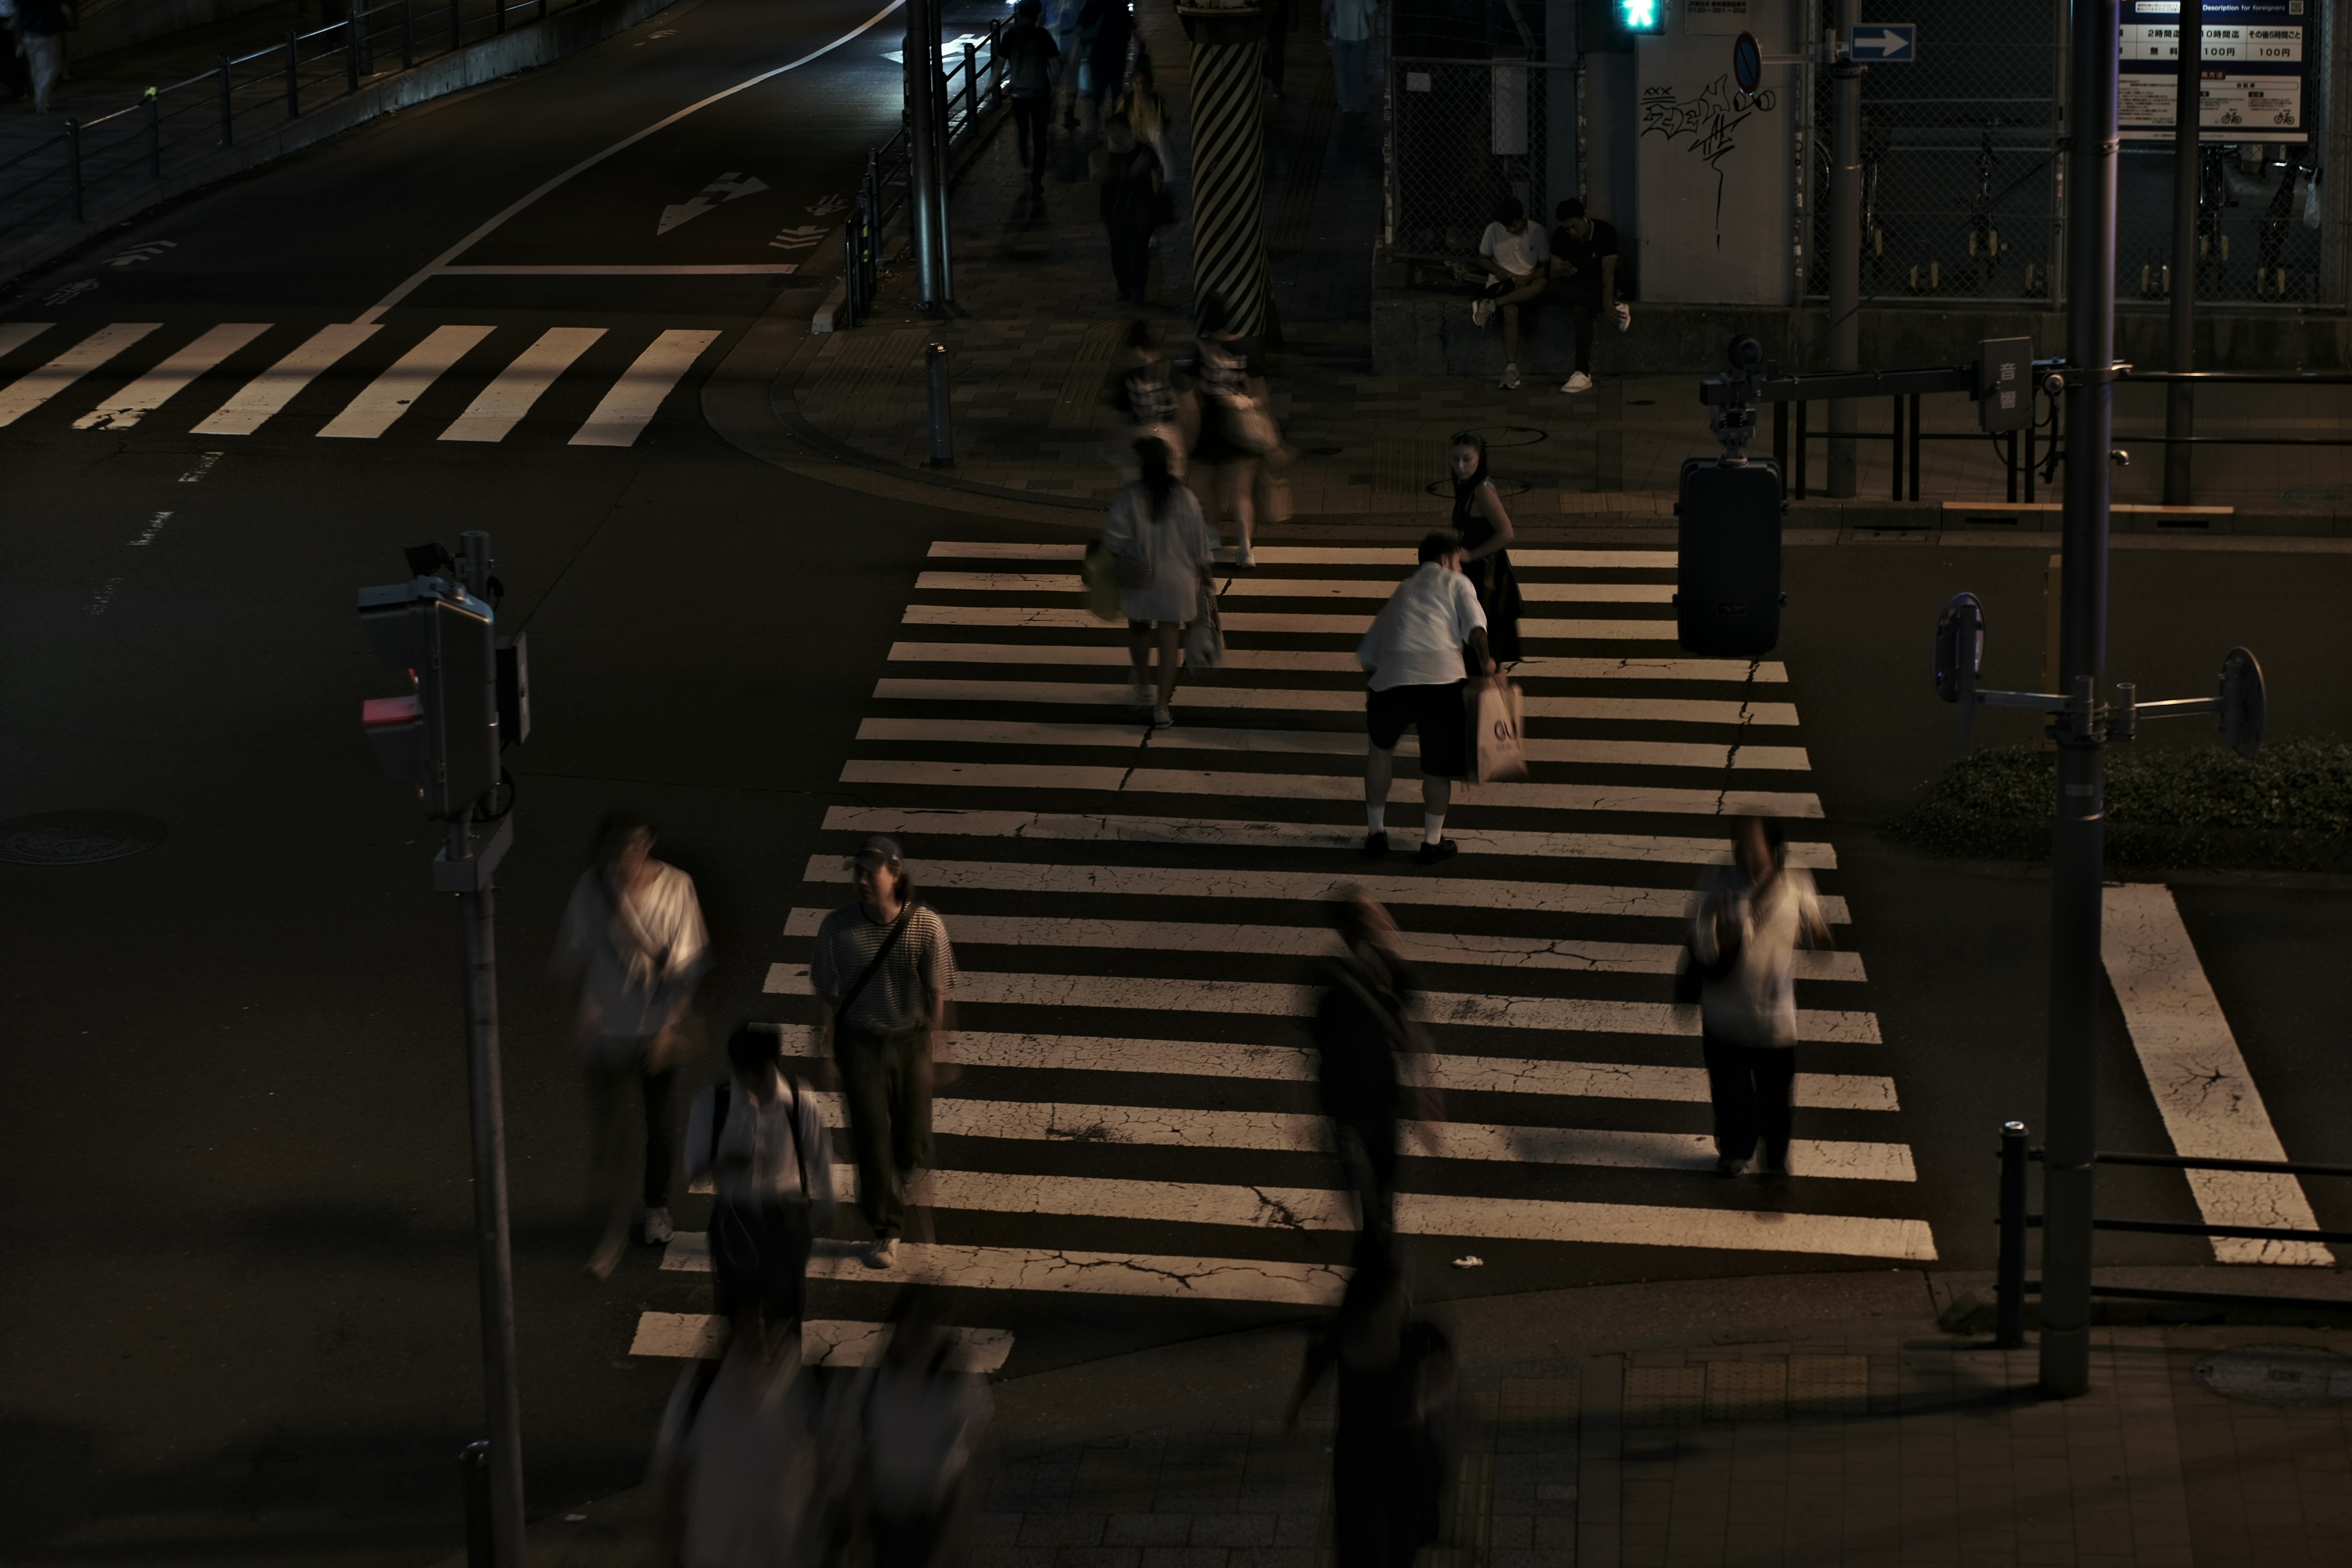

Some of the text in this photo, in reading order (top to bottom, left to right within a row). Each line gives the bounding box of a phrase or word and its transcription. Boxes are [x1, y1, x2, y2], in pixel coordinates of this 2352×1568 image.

[2249, 31, 2301, 39] その後5時間ごと
[2204, 48, 2235, 56] 100円
[2260, 48, 2290, 57] 100円
[1999, 362, 2017, 409] 音響
